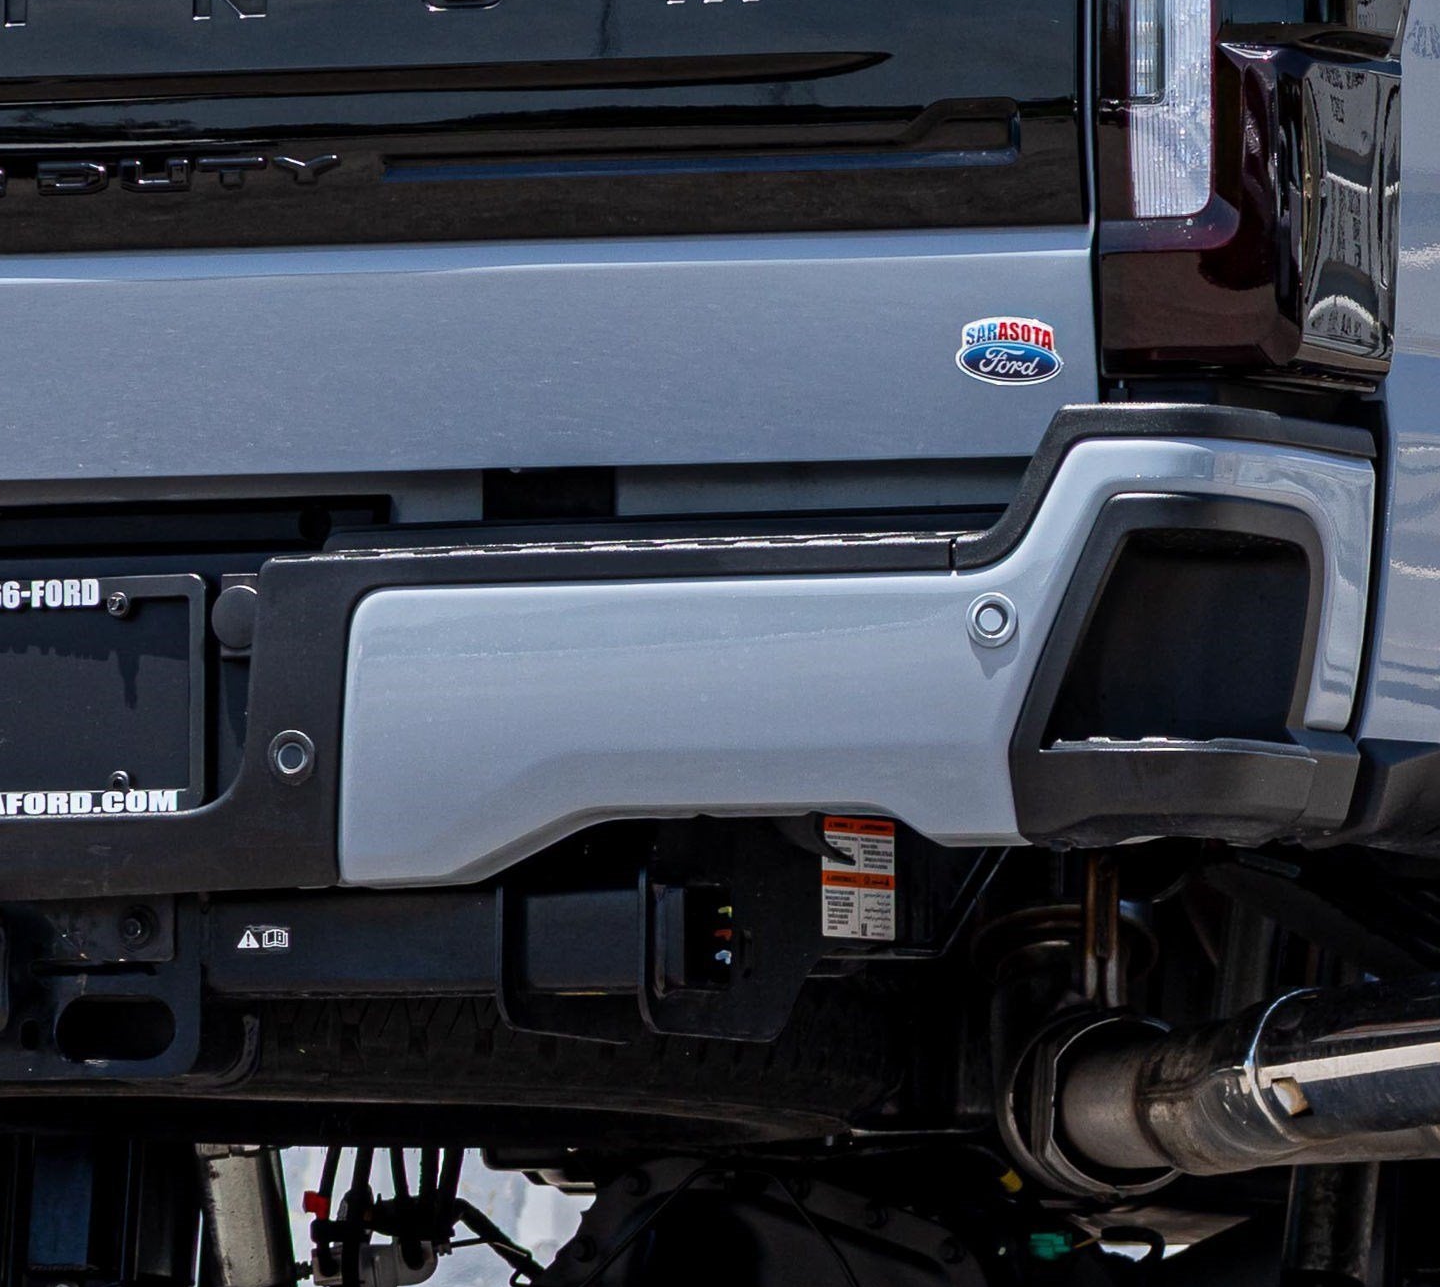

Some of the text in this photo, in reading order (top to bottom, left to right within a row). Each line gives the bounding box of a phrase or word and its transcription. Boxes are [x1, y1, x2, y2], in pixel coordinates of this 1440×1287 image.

[35, 152, 342, 197] DUTY
[966, 321, 1053, 351] SARASOTA
[979, 346, 1041, 376] Ford
